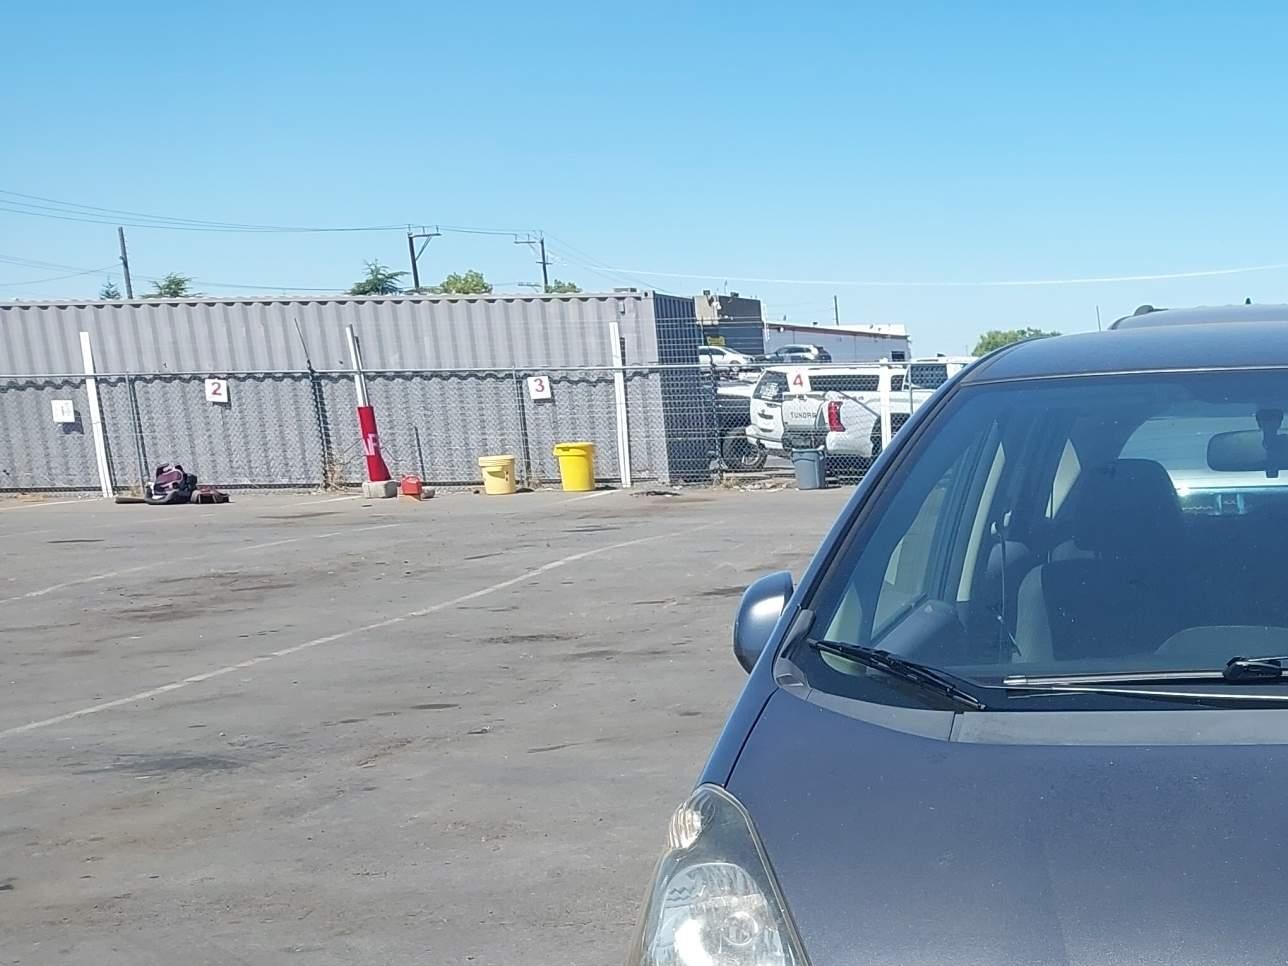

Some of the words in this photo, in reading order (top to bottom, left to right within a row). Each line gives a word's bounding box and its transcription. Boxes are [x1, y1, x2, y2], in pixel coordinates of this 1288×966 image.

[533, 378, 545, 393] 3
[793, 374, 804, 387] 4
[211, 381, 222, 396] 2
